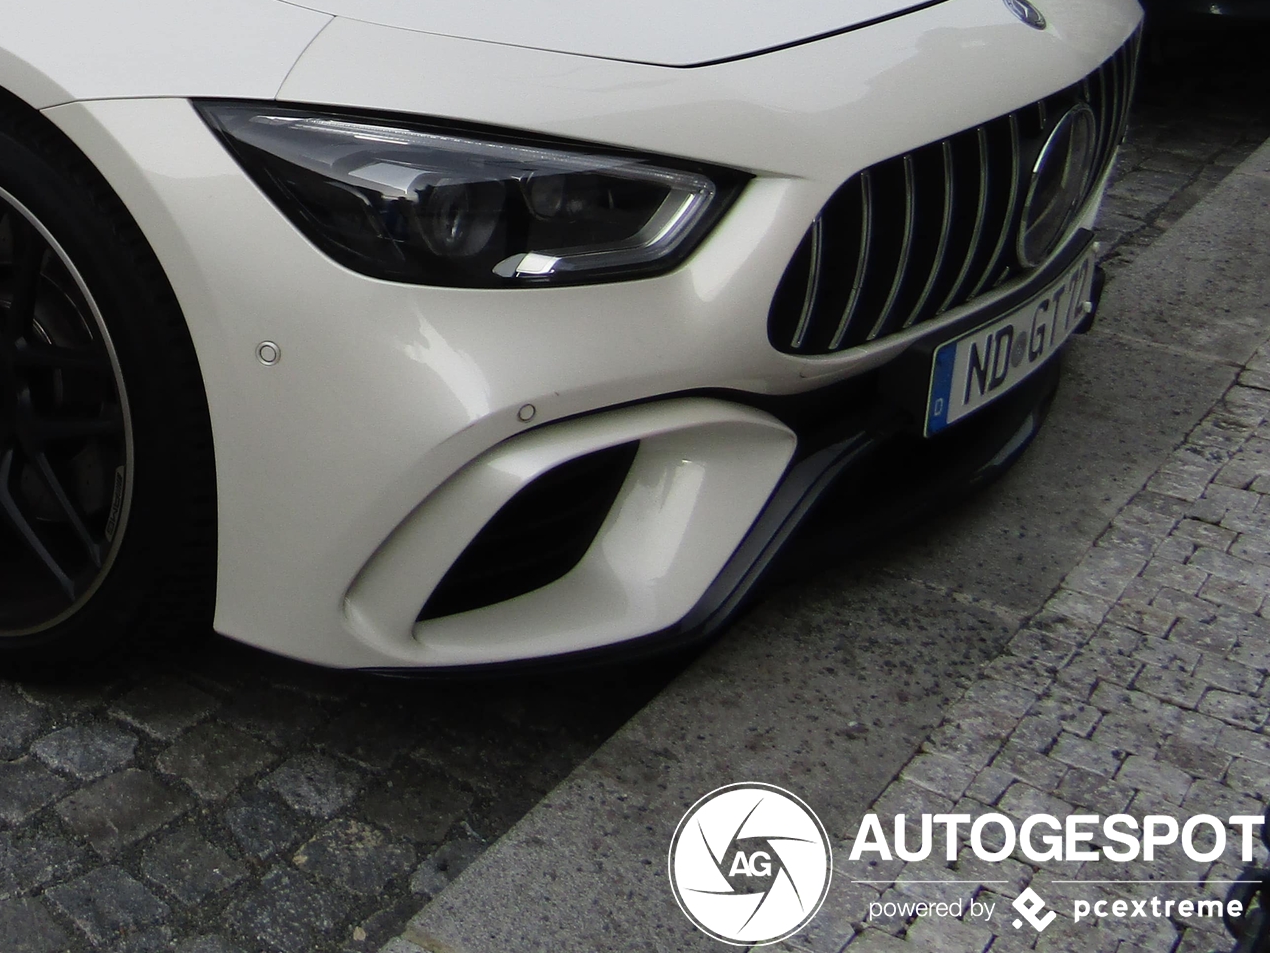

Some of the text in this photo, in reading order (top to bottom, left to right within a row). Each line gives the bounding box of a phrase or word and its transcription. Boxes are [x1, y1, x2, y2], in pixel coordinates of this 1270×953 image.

[963, 324, 1014, 406] ND
[1027, 284, 1066, 364] GT
[933, 397, 944, 416] D
